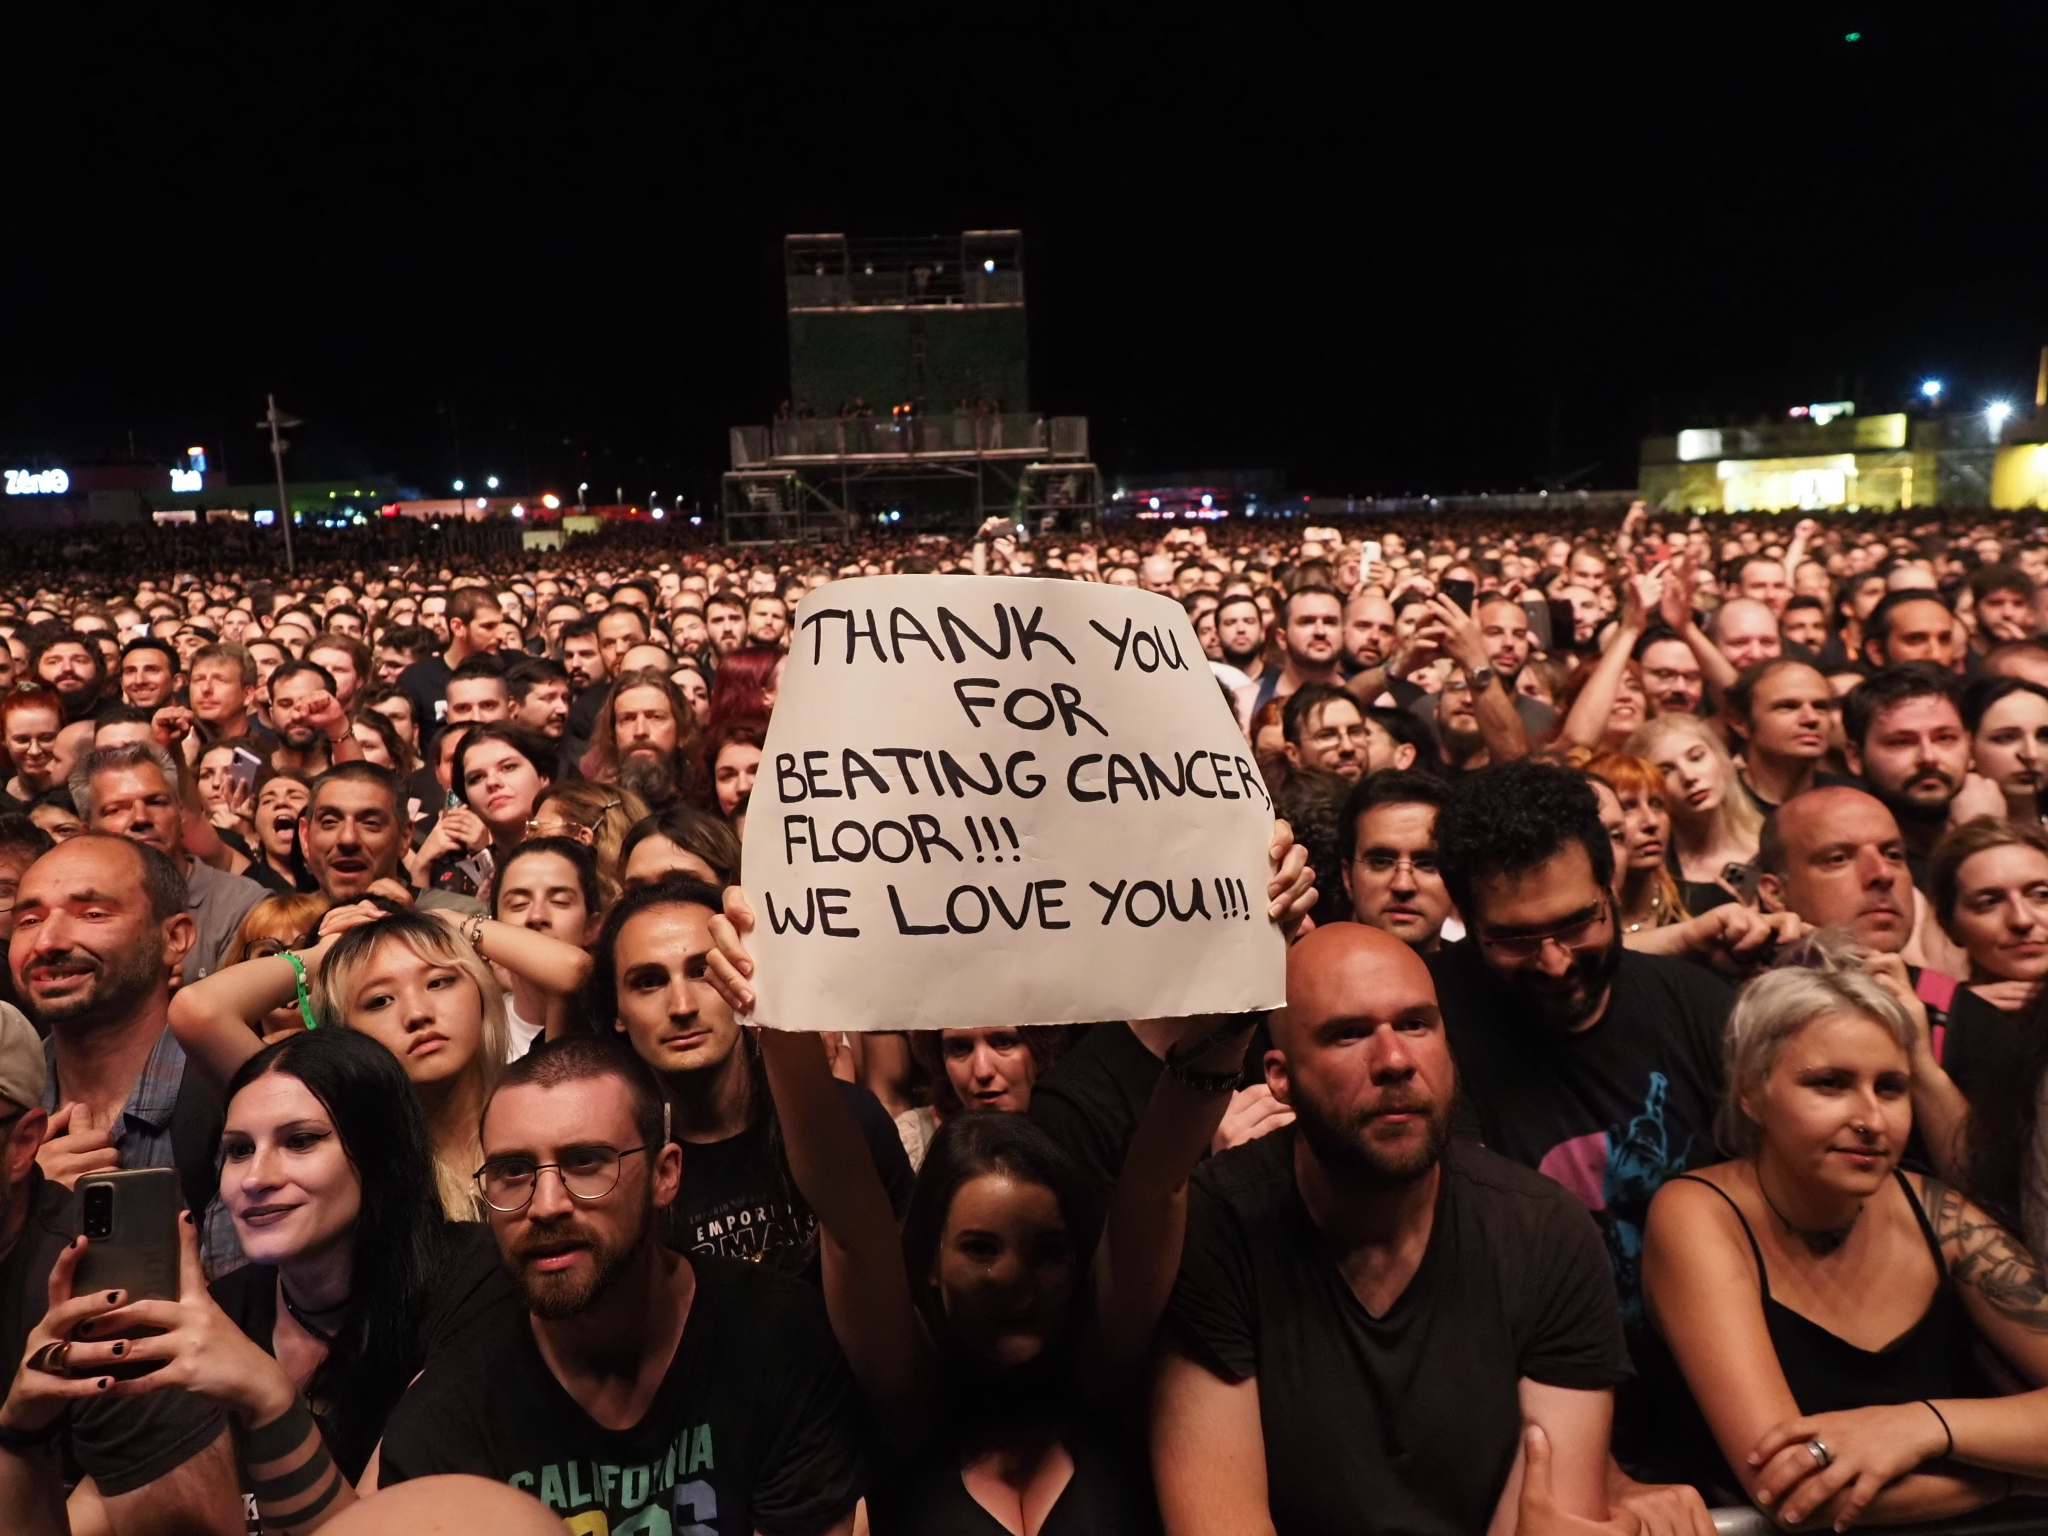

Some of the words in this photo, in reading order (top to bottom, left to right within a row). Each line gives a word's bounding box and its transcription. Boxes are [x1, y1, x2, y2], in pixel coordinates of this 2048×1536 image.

[801, 602, 1076, 666] THANK
[1088, 618, 1190, 673] YOU
[953, 677, 1109, 738] FOR
[775, 747, 1047, 804] BEATING
[1066, 749, 1271, 811] CANCER,
[783, 813, 1021, 865] FLOOR!!!
[764, 887, 860, 938] WE
[886, 879, 1071, 936] LOVE
[1088, 877, 1251, 928] YOU!!!
